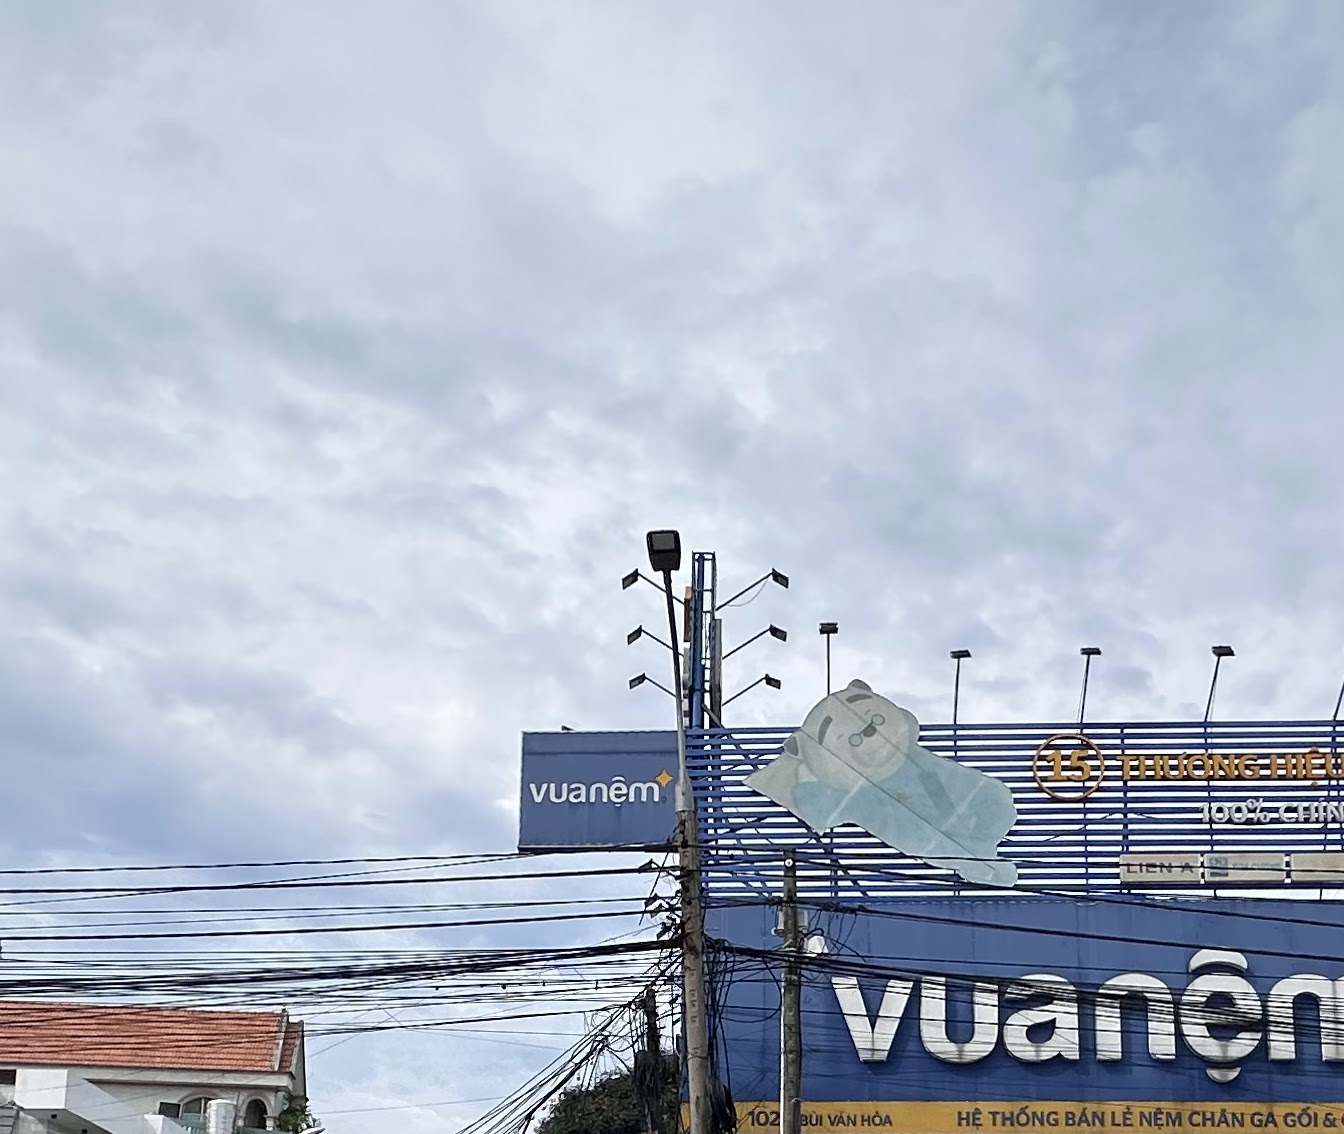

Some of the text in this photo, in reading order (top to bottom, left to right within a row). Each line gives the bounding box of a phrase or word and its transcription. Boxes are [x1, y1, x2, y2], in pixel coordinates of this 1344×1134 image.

[1045, 749, 1091, 782] 15
[1116, 750, 1261, 780] THƯƠNG
[529, 776, 660, 807] vuanệm
[1199, 797, 1272, 824] 100%
[861, 1110, 894, 1127] HÒA
[957, 1107, 983, 1130] HỆ
[988, 1105, 1060, 1128] THỐNG
[1065, 1106, 1106, 1128] BÁN
[1111, 1105, 1134, 1128] LẺ
[1139, 1107, 1182, 1130] NỆM
[1188, 1106, 1245, 1129] CHĂN
[1250, 1111, 1278, 1129] GA
[1283, 1106, 1318, 1129] GỐI
